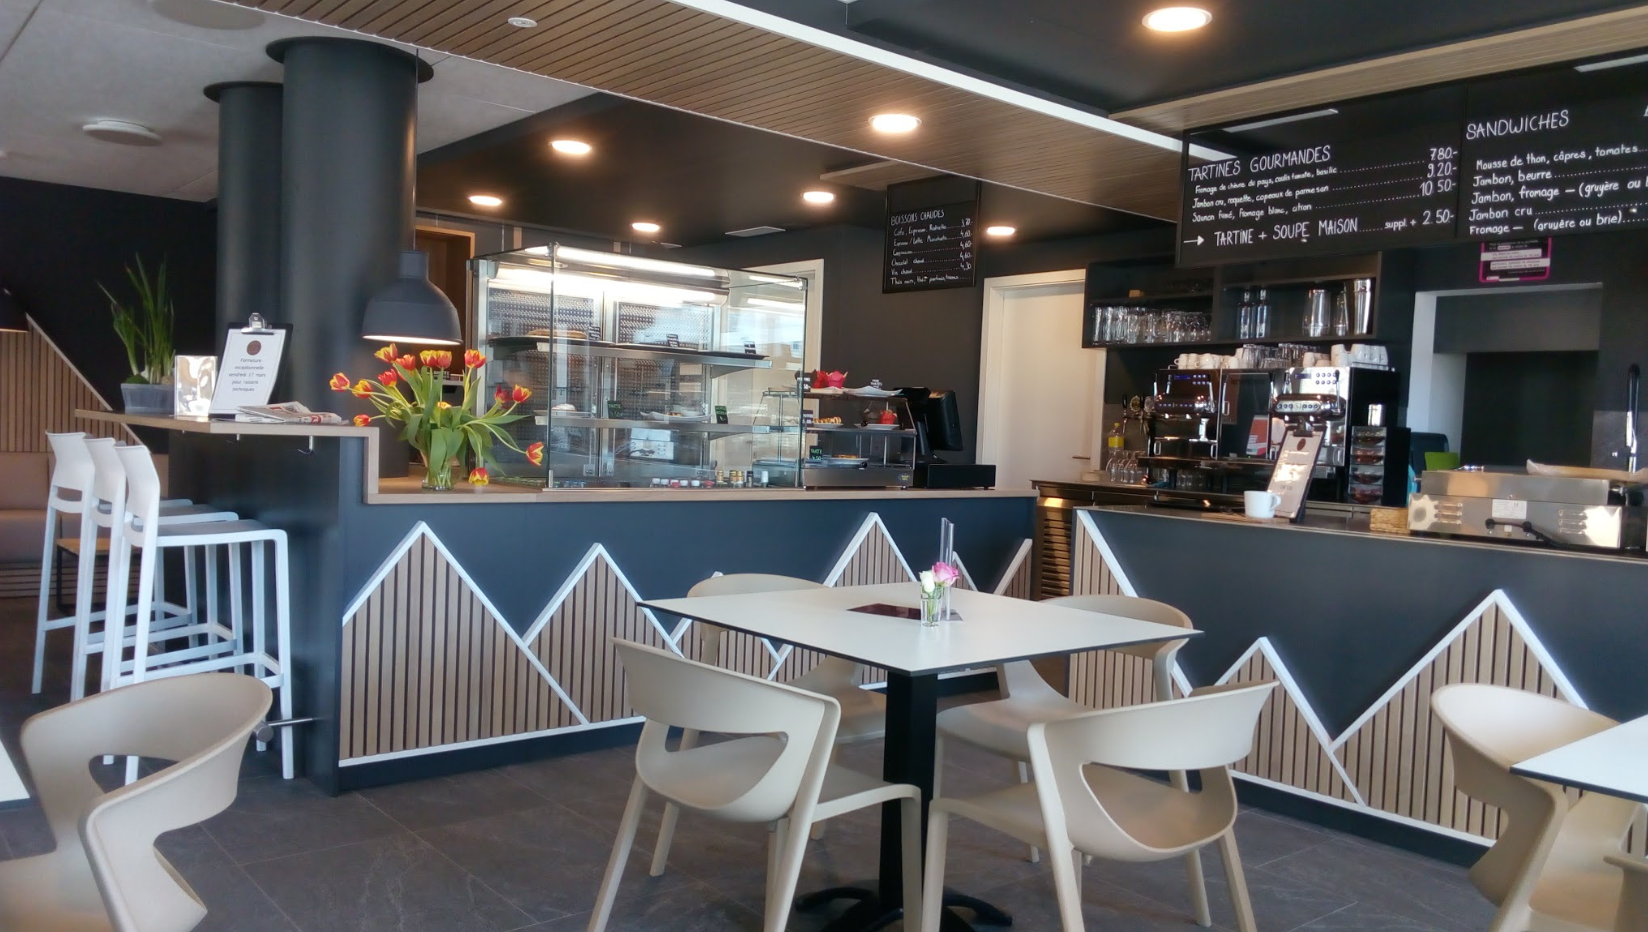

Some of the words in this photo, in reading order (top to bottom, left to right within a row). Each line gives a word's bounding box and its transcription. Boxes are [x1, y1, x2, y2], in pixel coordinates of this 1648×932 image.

[1466, 110, 1570, 140] SANDWICHES
[1188, 160, 1241, 182] TARTINES
[1249, 145, 1331, 173] GOURMANDES
[1476, 159, 1508, 171] Mousse
[1510, 155, 1523, 167] de
[1526, 152, 1550, 164] thon,
[1595, 144, 1639, 157] tomates
[1195, 184, 1218, 195] Fromage
[1219, 183, 1226, 191] de
[1256, 178, 1274, 188] pays,
[1274, 173, 1291, 183] coulis
[1316, 166, 1338, 176] basilic
[1472, 172, 1514, 187] Jambon,
[1517, 169, 1552, 182] beurre
[1192, 197, 1214, 209] Jambon
[1255, 192, 1284, 204] copeaux
[1284, 188, 1293, 197] de
[1295, 185, 1329, 200] parmesan
[1471, 190, 1514, 205] Jambon,
[1519, 185, 1560, 201] fromage
[1627, 180, 1641, 189] ou
[1218, 210, 1235, 220] fumé,
[1239, 207, 1265, 221] fromage
[1268, 205, 1289, 215] blanc,
[1292, 202, 1312, 213] citron
[1468, 207, 1509, 222] Jambon
[1514, 207, 1533, 217] cru
[1469, 225, 1510, 235] Fromage
[1579, 218, 1592, 227] ou
[1596, 209, 1623, 226] brie)
[1214, 228, 1254, 247] TARTINE
[1272, 221, 1310, 240] SOUPE
[1318, 217, 1358, 237] MAISON
[1384, 218, 1408, 232] suppl.
